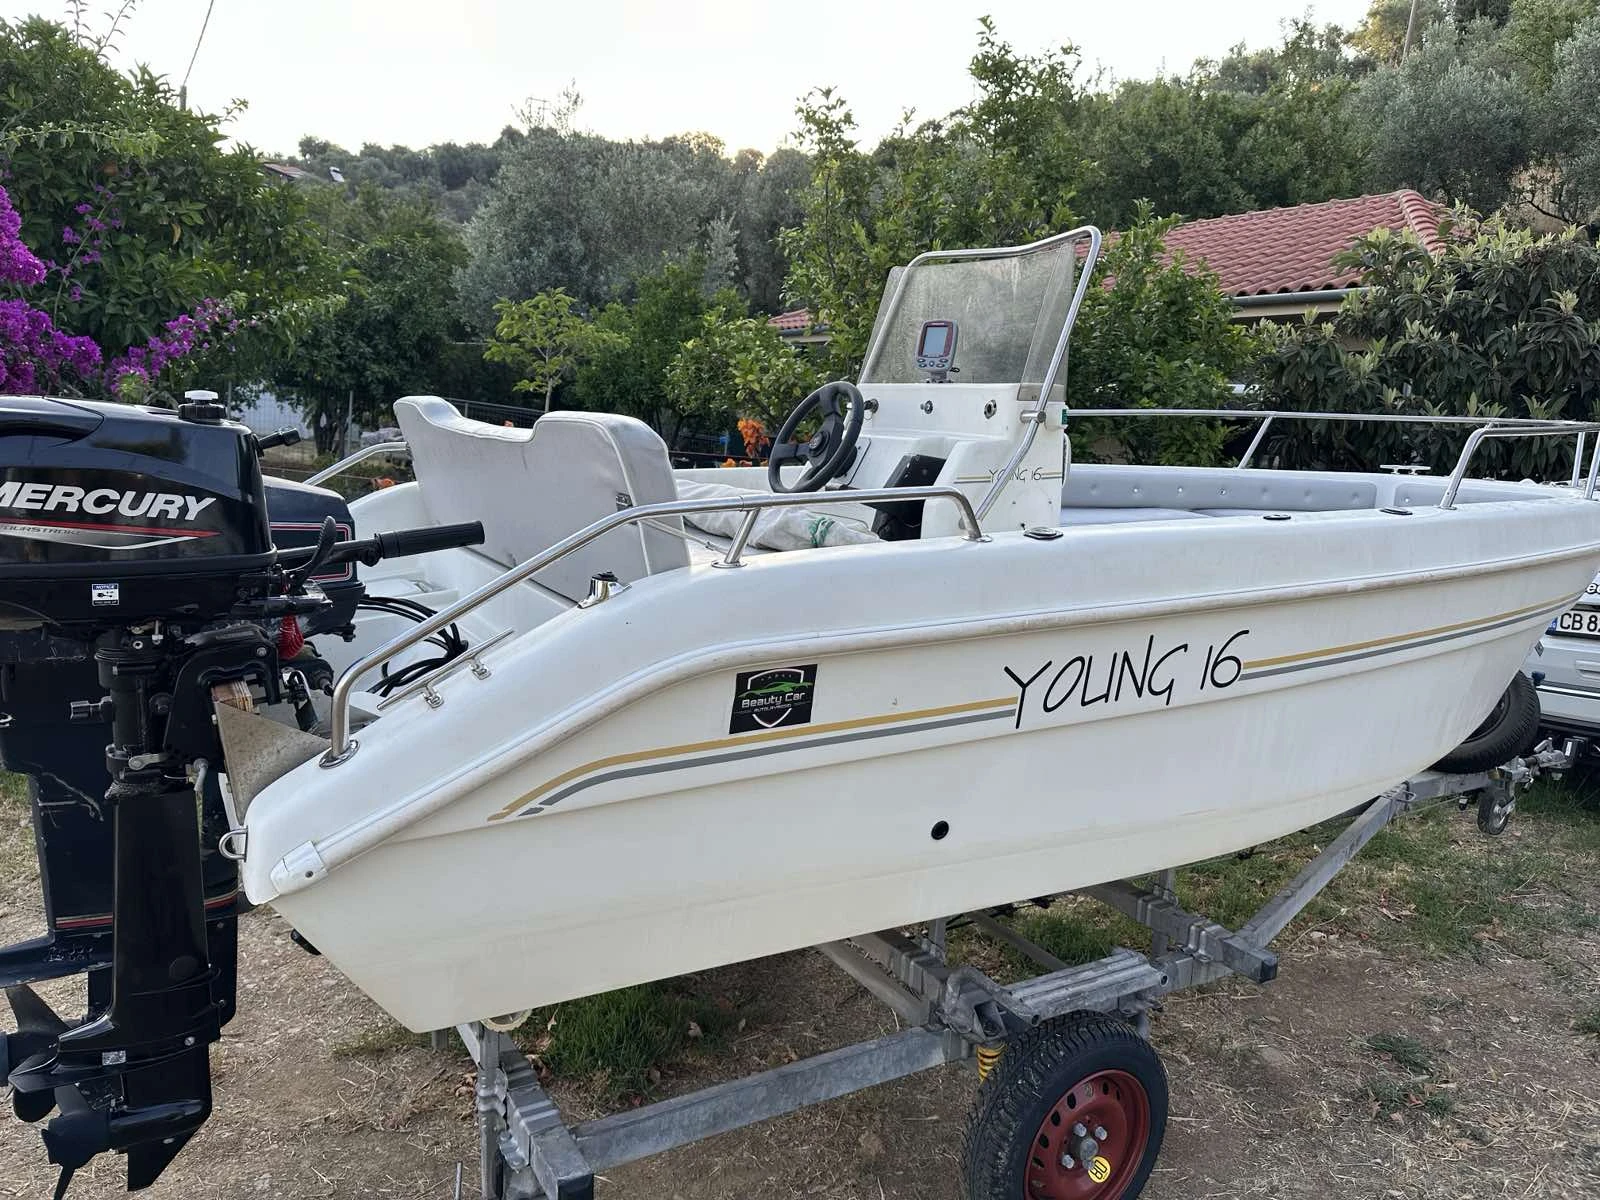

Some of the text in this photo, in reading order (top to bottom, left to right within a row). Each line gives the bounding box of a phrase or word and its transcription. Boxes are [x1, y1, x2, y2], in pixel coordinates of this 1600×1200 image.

[989, 466, 1043, 483] YONG 16
[1560, 612, 1600, 632] CB 8
[1004, 629, 1249, 729] YOUNG 16
[741, 692, 806, 708] Beauty Car
